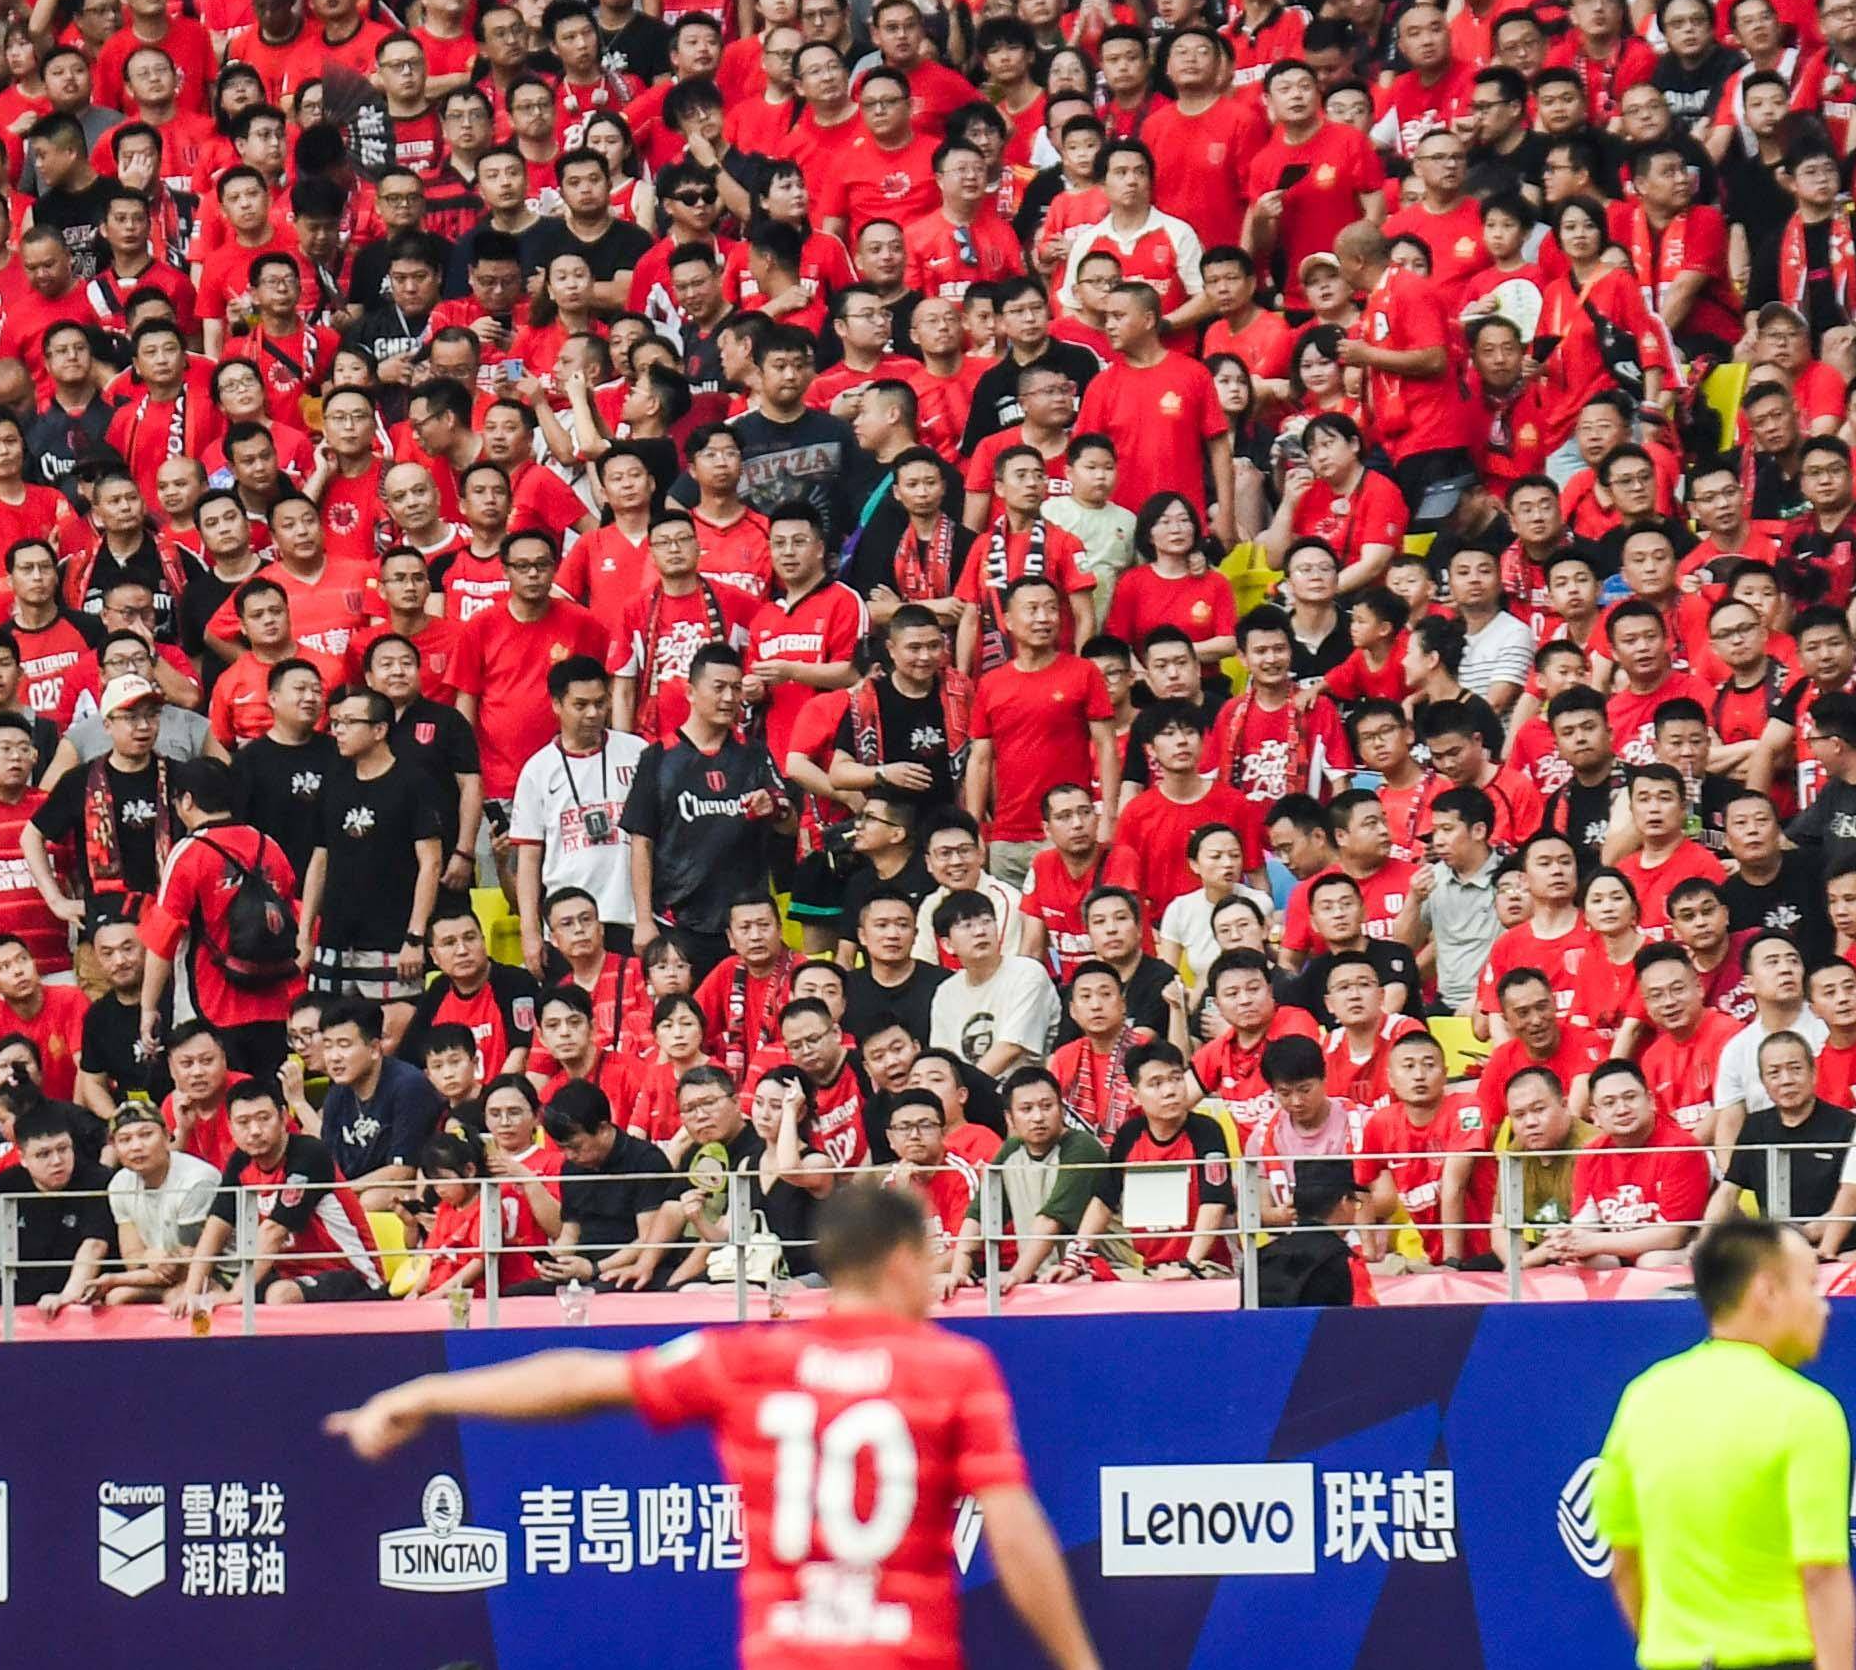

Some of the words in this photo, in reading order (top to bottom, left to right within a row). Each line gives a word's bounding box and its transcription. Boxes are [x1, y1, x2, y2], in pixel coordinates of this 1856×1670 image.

[98, 1481, 165, 1506] Chevron
[757, 1393, 915, 1564] 10
[181, 1482, 286, 1538] 雪佛龙
[1121, 1491, 1294, 1546] Lenovo
[1322, 1470, 1458, 1563] 联想
[181, 1542, 286, 1596] 润滑油
[389, 1542, 498, 1575] TSINGTAO
